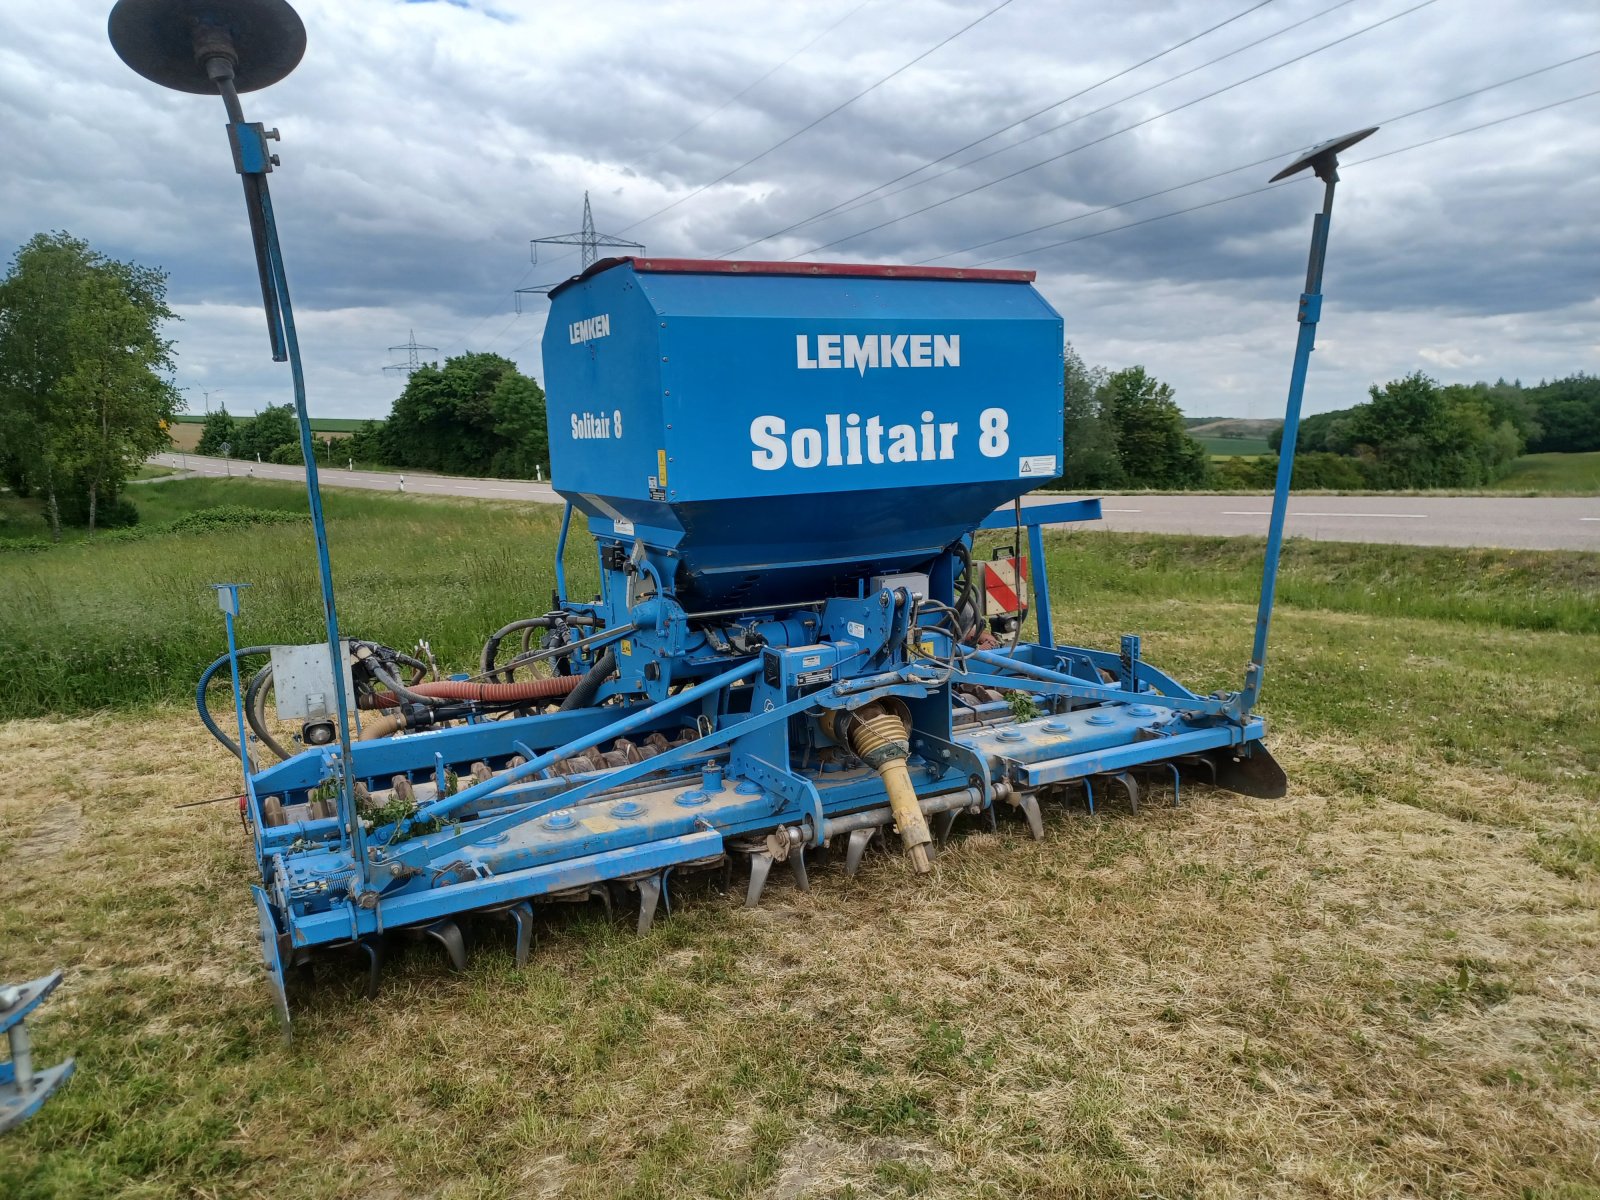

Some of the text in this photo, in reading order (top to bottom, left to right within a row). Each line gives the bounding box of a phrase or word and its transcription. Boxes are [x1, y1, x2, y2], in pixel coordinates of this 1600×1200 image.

[568, 313, 611, 345] LEMKEN
[796, 334, 960, 377] LEMKEN
[571, 410, 622, 441] Solitair 8
[750, 407, 1010, 471] Solitair 8
